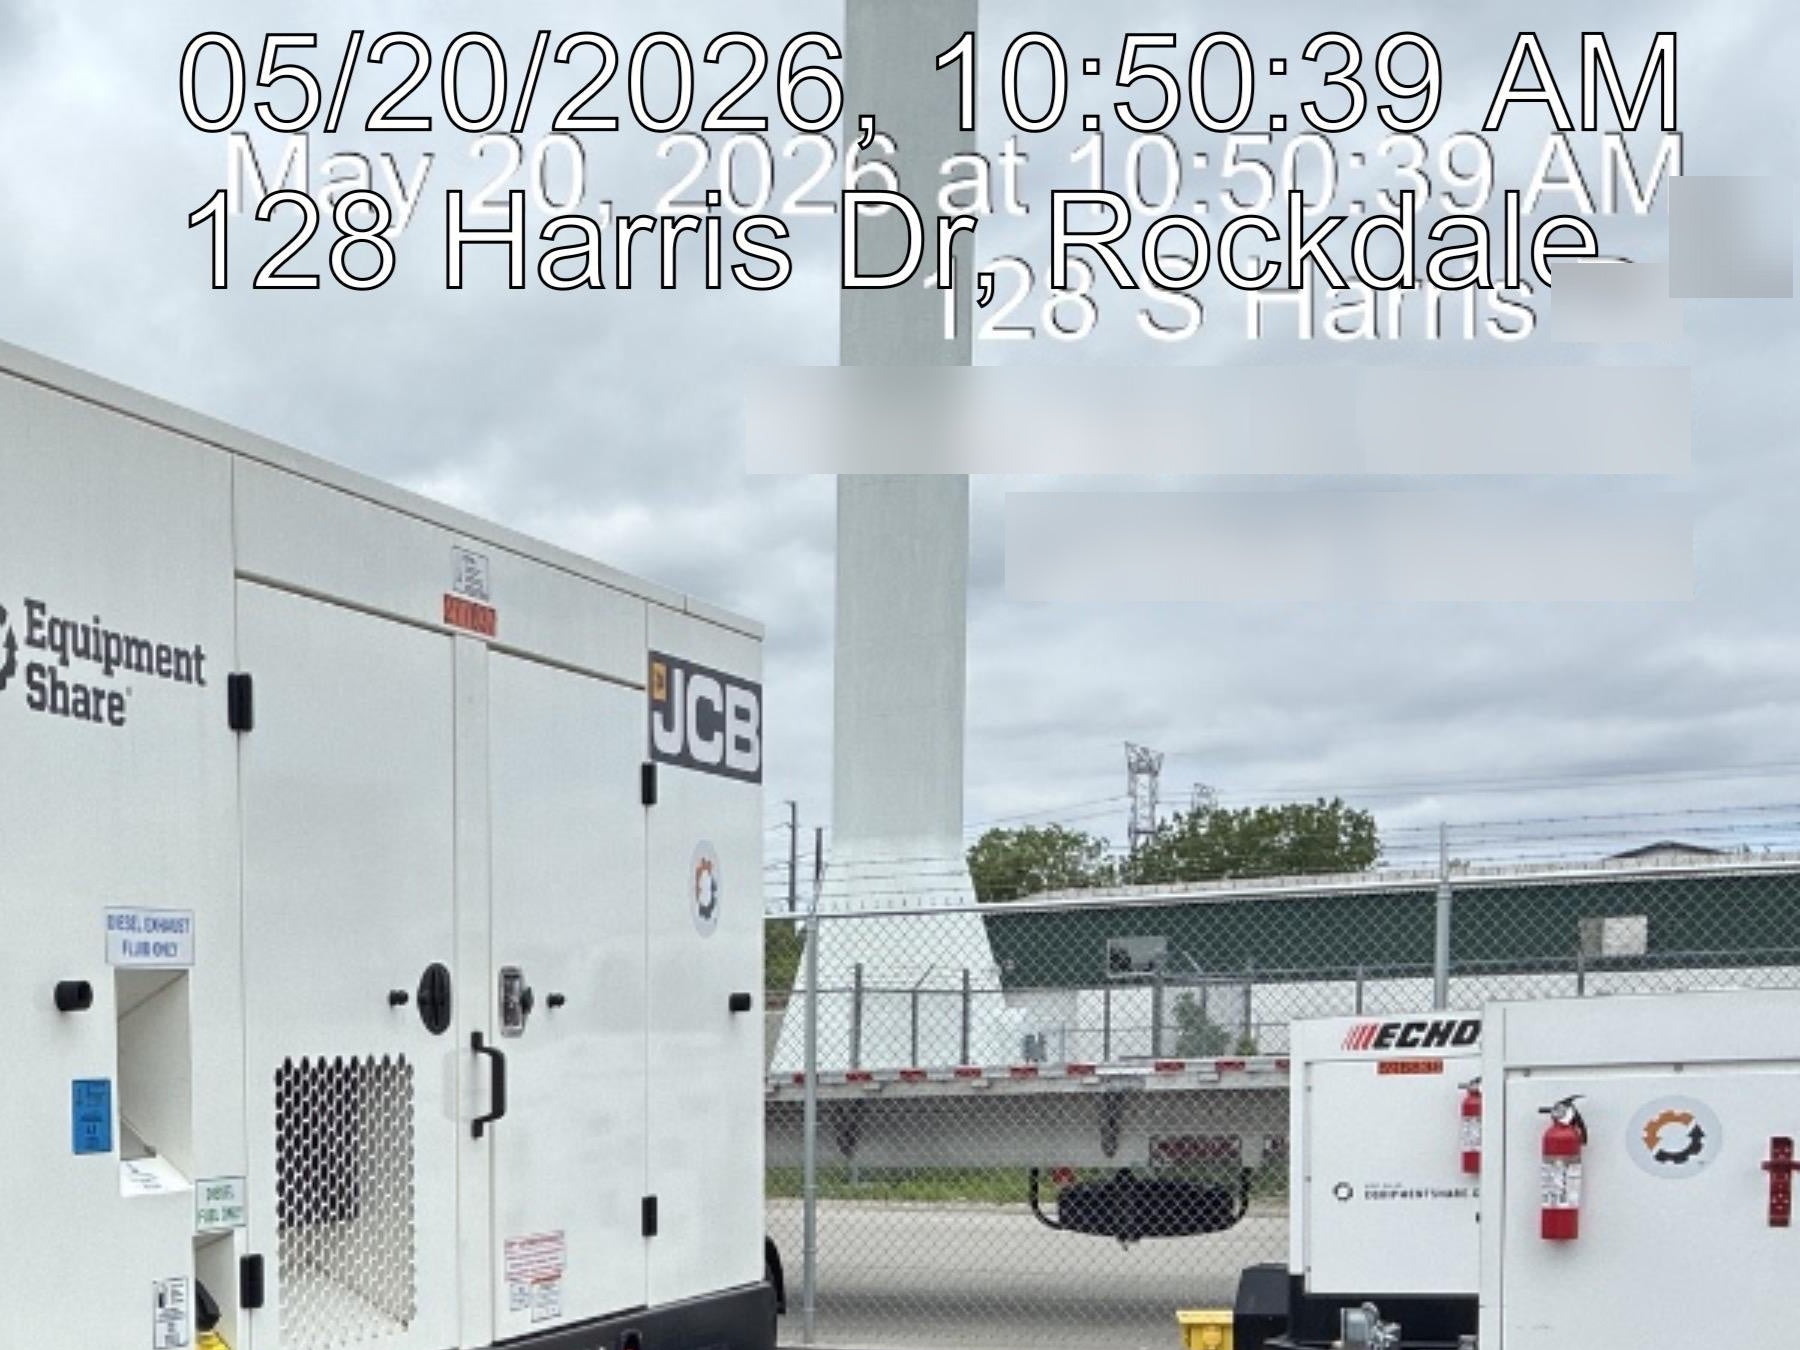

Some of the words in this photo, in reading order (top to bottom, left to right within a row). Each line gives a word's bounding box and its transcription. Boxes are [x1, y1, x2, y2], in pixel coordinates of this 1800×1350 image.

[23, 596, 206, 687] Equipment
[25, 661, 128, 727] Share
[651, 667, 762, 773] JCB
[1373, 1019, 1483, 1050] ECHO
